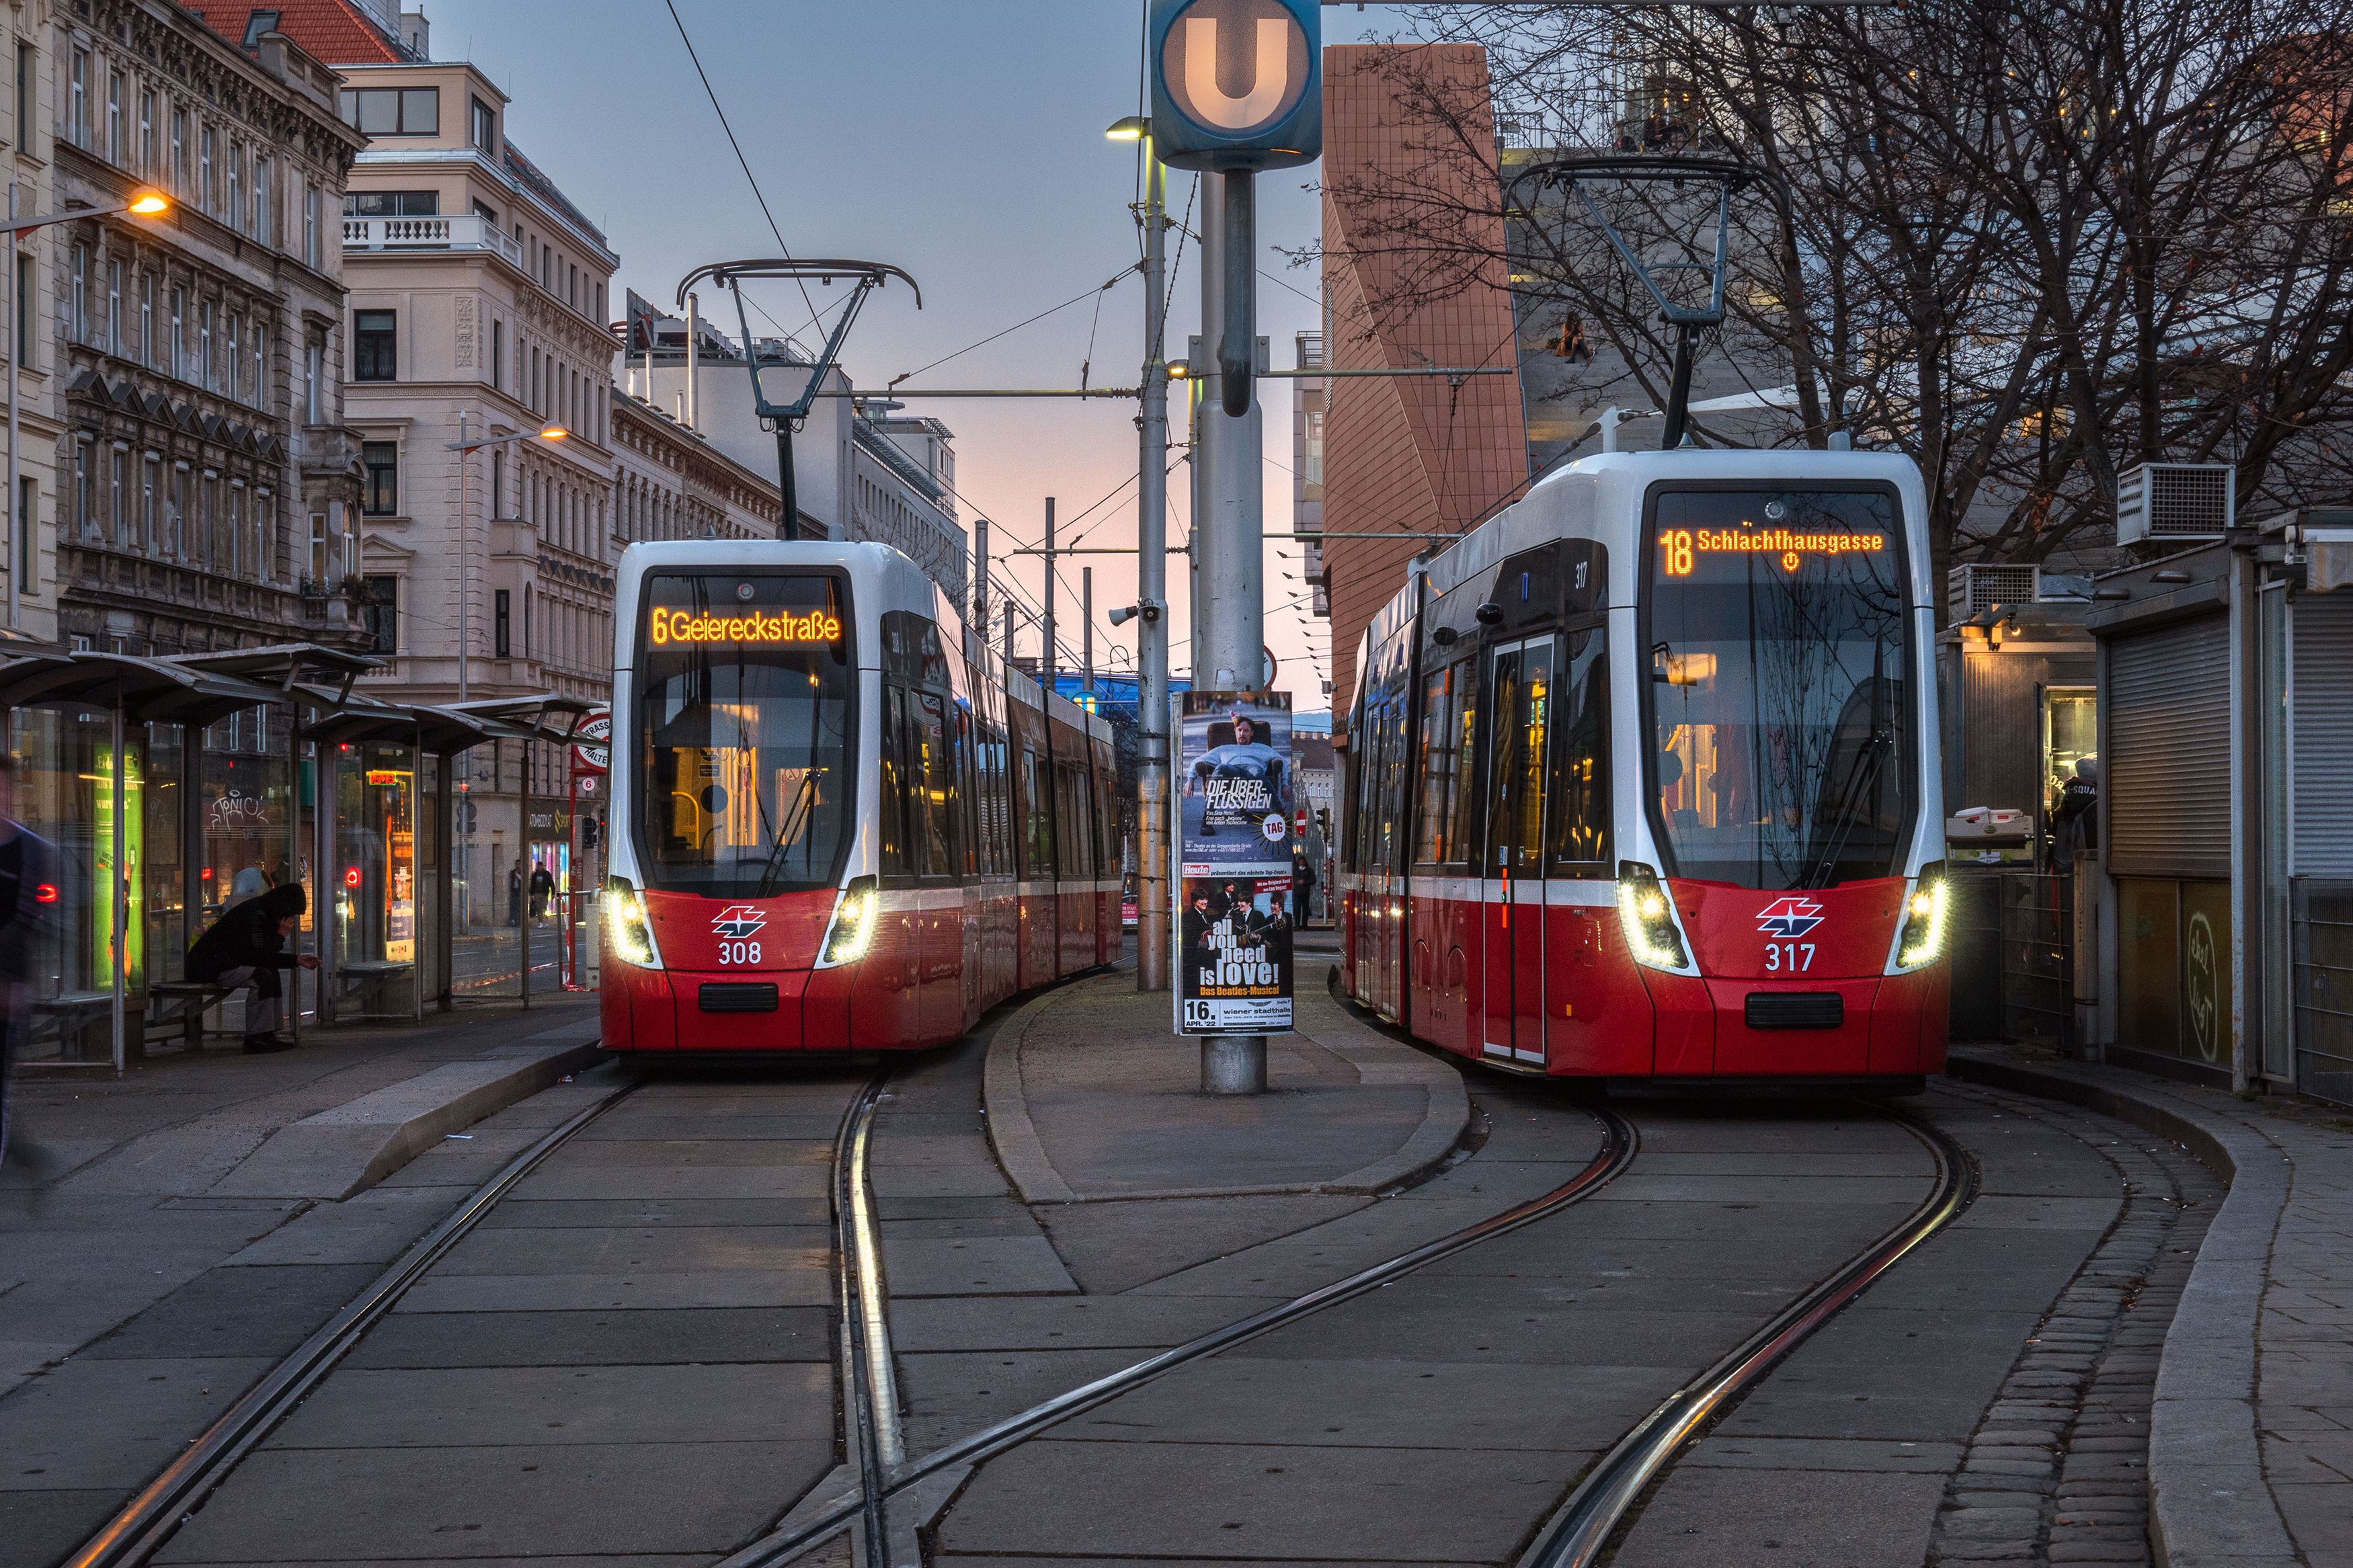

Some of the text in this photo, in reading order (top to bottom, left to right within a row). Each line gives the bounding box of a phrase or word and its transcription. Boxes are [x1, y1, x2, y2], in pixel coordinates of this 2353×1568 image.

[1185, 17, 1288, 129] U
[1659, 530, 1883, 574] 18 Schlachthausgasse
[1575, 561, 1587, 589] 317
[653, 607, 840, 644] 6 Geiereckstraße
[586, 721, 610, 737] TRASS
[584, 749, 608, 764] HALTE
[586, 780, 592, 788] 6
[1207, 777, 1267, 794] DIE ÜBER-
[1206, 792, 1272, 809] FLÜSSIGEN
[1266, 822, 1283, 834] TAG
[1185, 866, 1209, 874] Heute
[1213, 919, 1232, 935] all
[1207, 935, 1237, 950] you
[718, 942, 762, 964] 308
[1222, 944, 1266, 963] need
[1765, 943, 1816, 971] 317
[1200, 958, 1279, 985] is love!
[1200, 985, 1279, 996] Das Beatles-Musical
[1186, 1001, 1215, 1020] 16.
